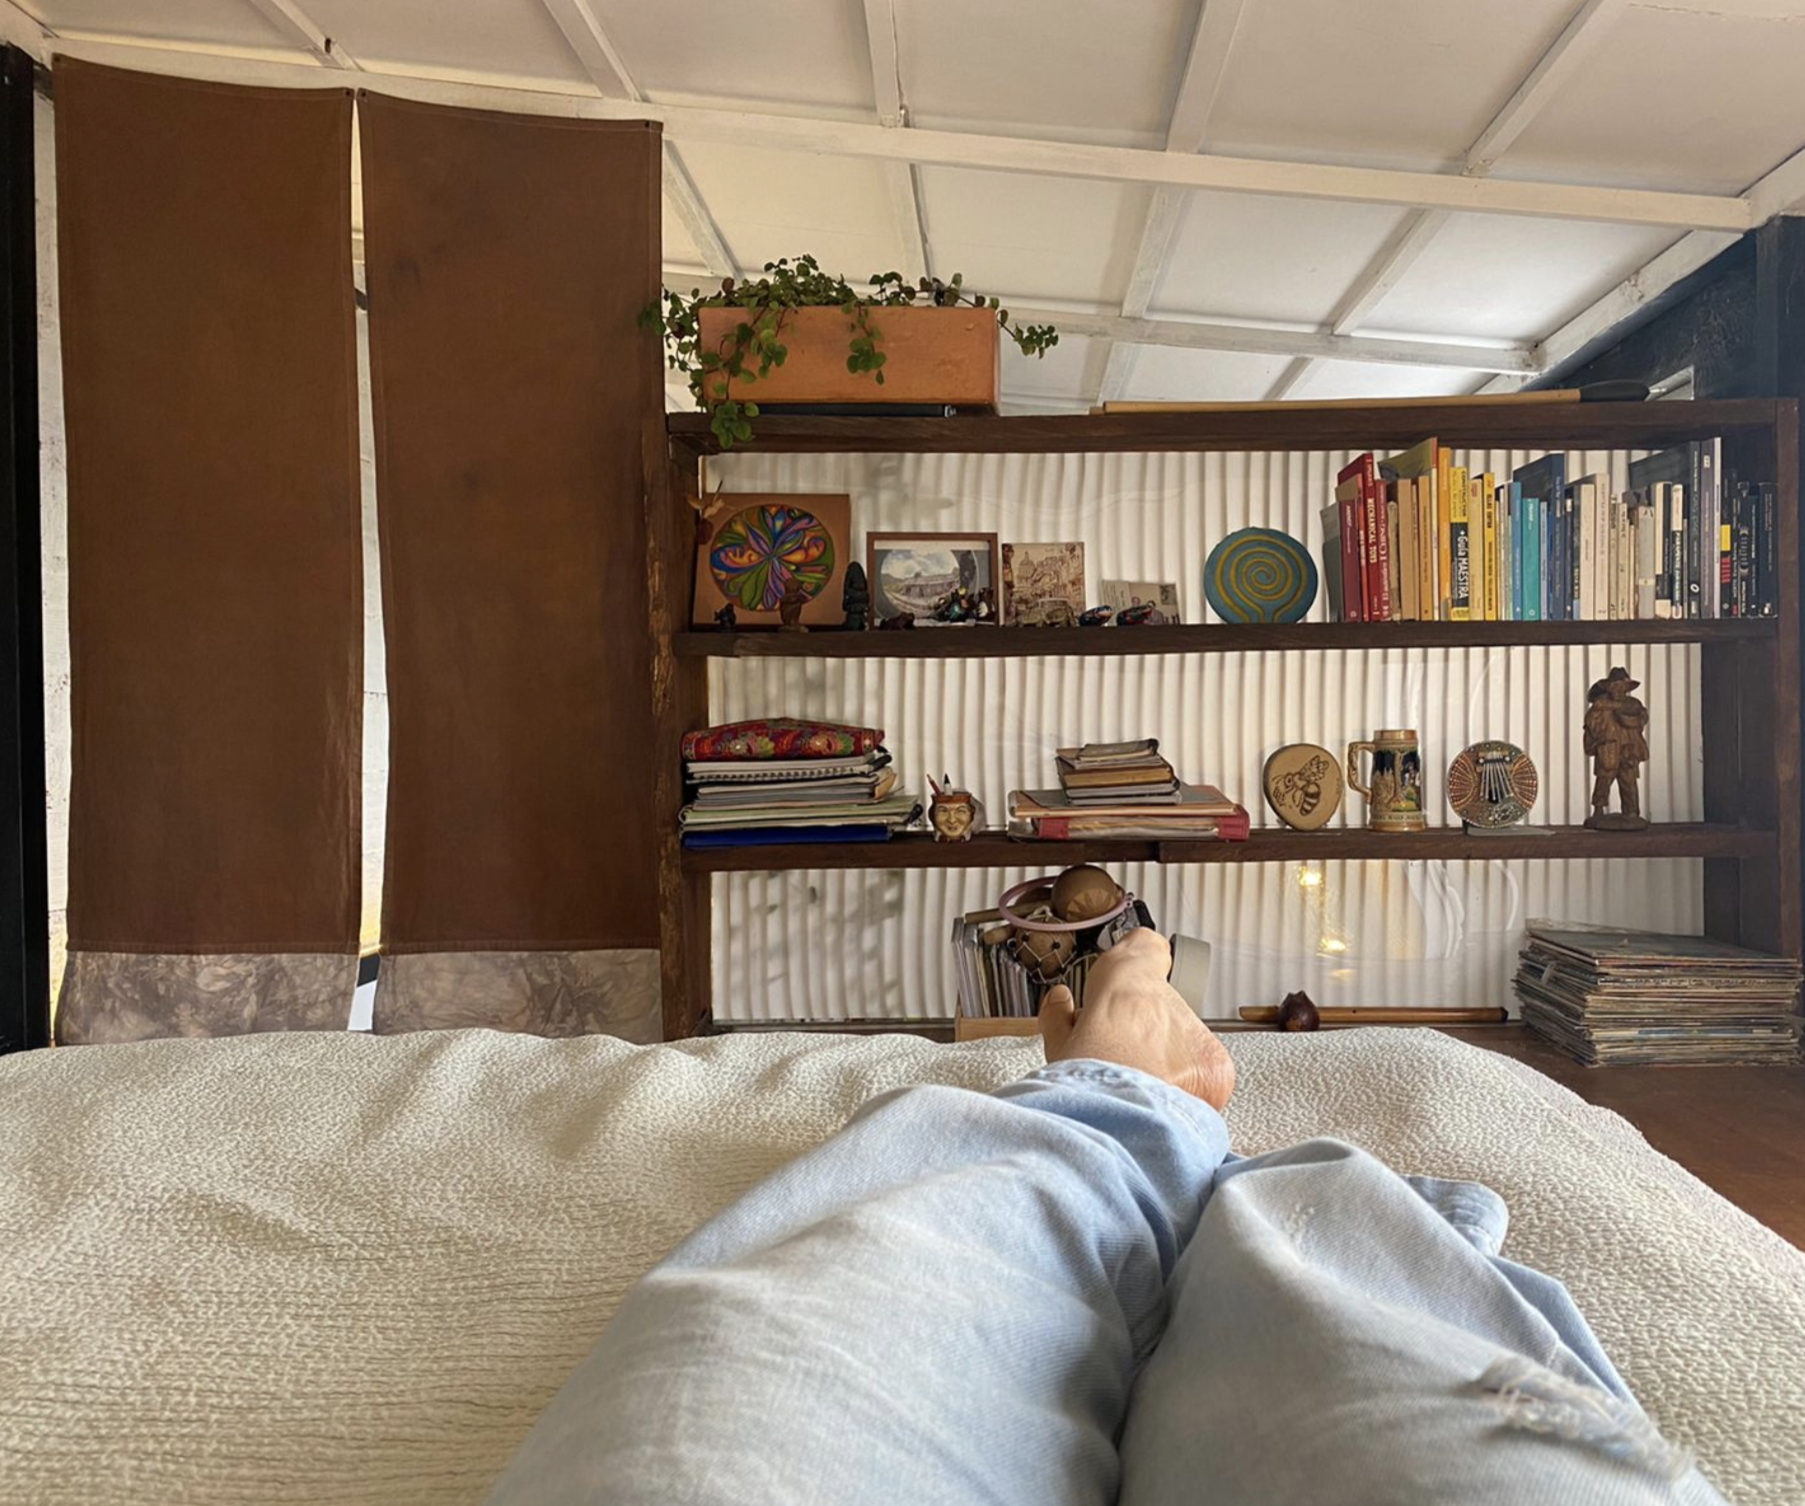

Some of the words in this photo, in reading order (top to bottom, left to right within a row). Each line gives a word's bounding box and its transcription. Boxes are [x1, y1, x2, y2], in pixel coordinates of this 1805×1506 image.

[1367, 498, 1377, 543] MECHANICAL
[1369, 546, 1378, 564] TOYS
[1458, 557, 1469, 599] MAESTRA
